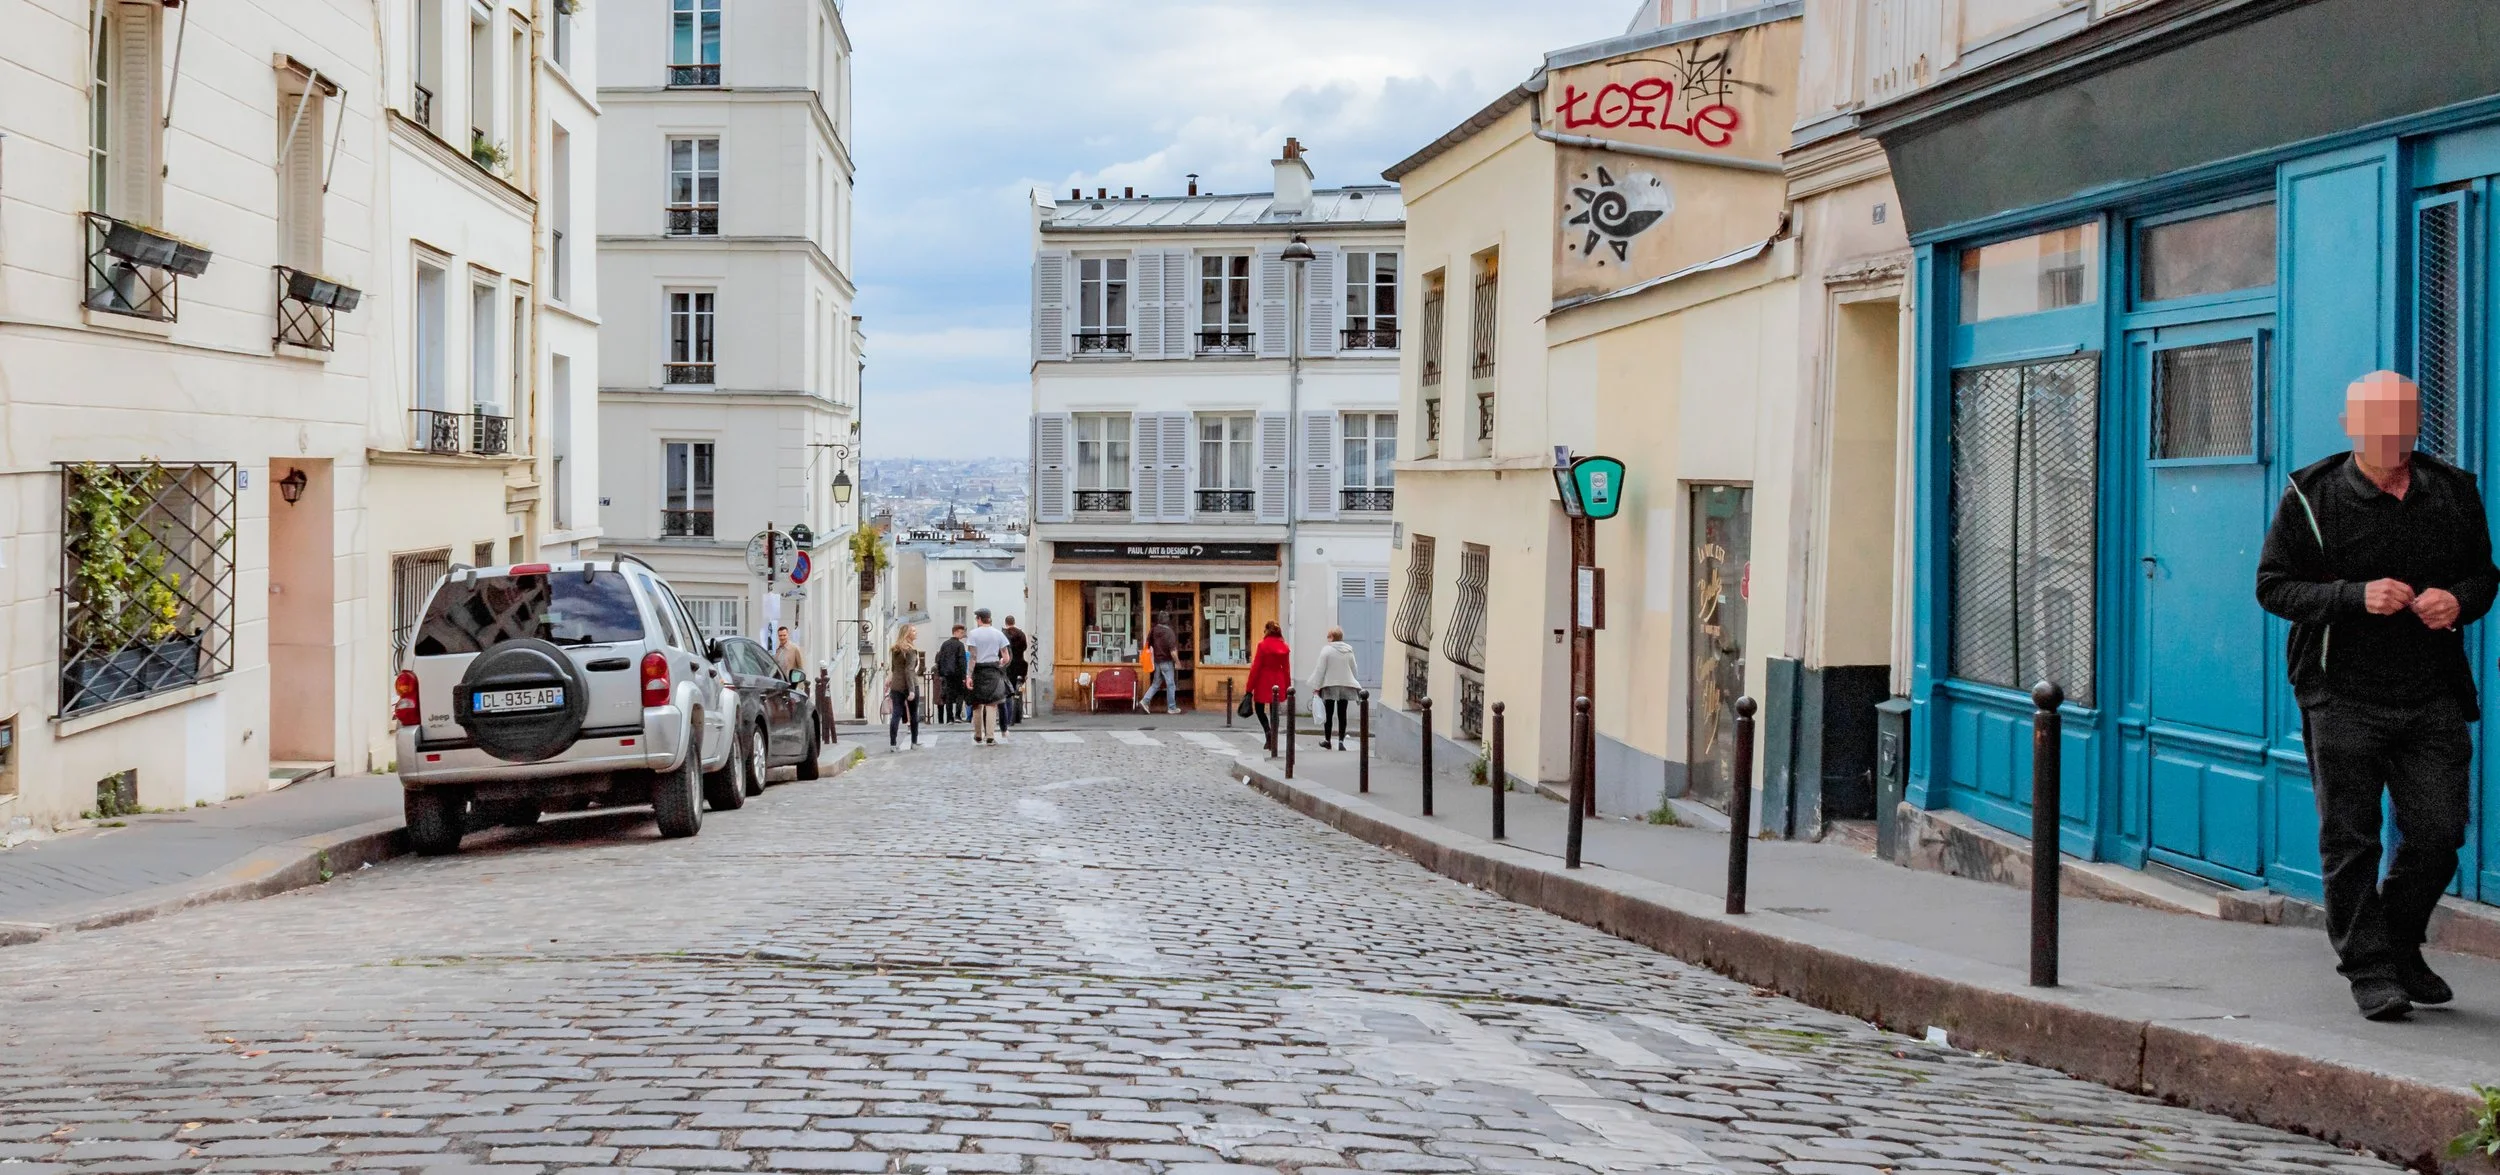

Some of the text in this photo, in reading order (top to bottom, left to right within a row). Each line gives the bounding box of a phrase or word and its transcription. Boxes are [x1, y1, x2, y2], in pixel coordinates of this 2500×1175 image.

[1127, 546, 1143, 555] PAUL
[1148, 546, 1160, 555] ART
[1160, 546, 1167, 555] &
[1166, 546, 1189, 555] DESIGN
[1715, 544, 1726, 565] EST
[482, 689, 555, 708] CL-935-AB
[428, 713, 450, 723] Jeep
